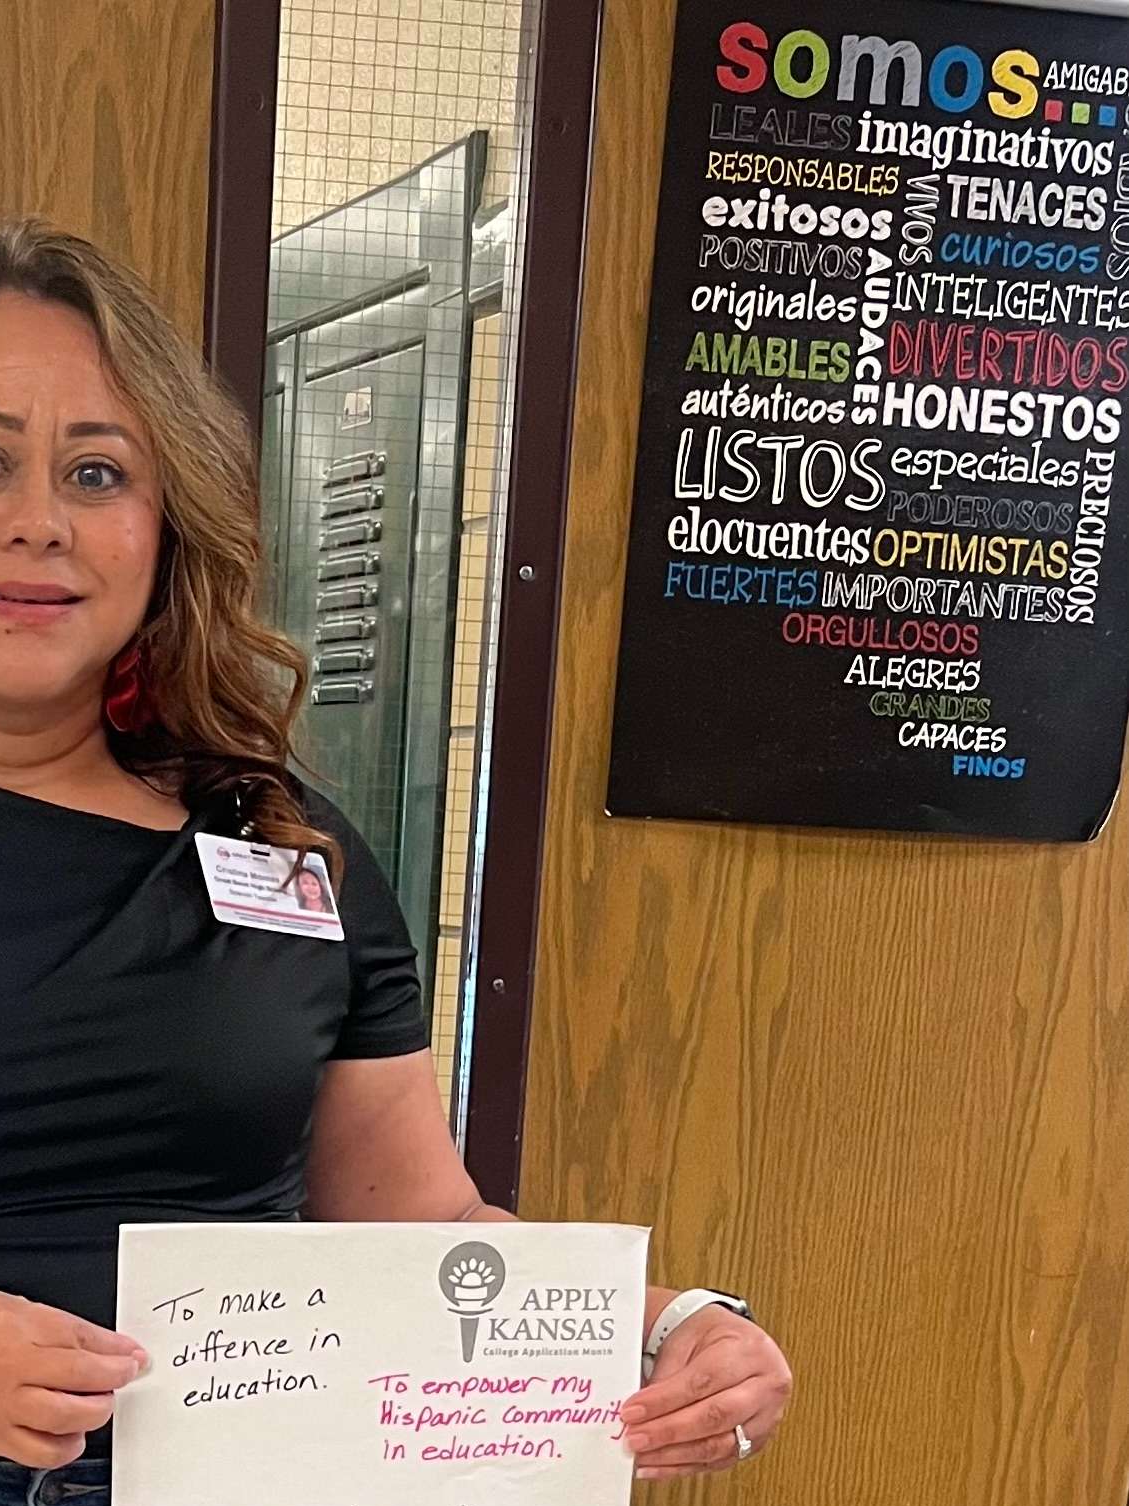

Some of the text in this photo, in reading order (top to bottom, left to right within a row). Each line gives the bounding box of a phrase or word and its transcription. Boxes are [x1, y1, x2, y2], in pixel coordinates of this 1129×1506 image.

[1043, 60, 1129, 97] AMIGAB
[710, 103, 853, 151] LEALES
[856, 111, 1115, 177] imaginativos
[705, 152, 899, 195] RESPONSABLES
[702, 188, 892, 242] exitosos
[898, 173, 941, 264] VIVOS
[947, 175, 1107, 231] TENACES
[699, 235, 863, 280] POSITIVOS
[941, 231, 1101, 273] curiosos
[691, 279, 857, 330] originales
[892, 272, 1129, 331] INTELIGENTES
[851, 247, 892, 424] AUDACES
[888, 320, 1129, 393] DIVERTIDOS
[685, 333, 851, 383] AMABLES
[681, 379, 846, 423] auténticos
[883, 382, 1121, 444] HONESTOS
[675, 426, 886, 511] LISTOS
[890, 442, 1081, 491] especiales
[886, 491, 1073, 533] PODEROSOS
[668, 506, 870, 567] elocuentes
[873, 529, 1068, 579] OPTIMISTAS
[1065, 448, 1116, 625] PRECIOSOS
[664, 562, 817, 606] FUERTES
[821, 571, 1064, 623] IMPORTANTES
[783, 613, 979, 654] ORGULLOSOS
[844, 655, 981, 691] ALEGRES
[869, 691, 991, 723] GRANDES
[898, 722, 1006, 752] CAPACES
[953, 755, 1027, 779] FINOS
[152, 1287, 326, 1324] To make a
[519, 1288, 618, 1311] APPLY
[172, 1327, 341, 1367] diffence in
[487, 1318, 615, 1341] KANSAS
[483, 1347, 613, 1358] College Application Month
[183, 1368, 327, 1407] education.
[368, 1374, 410, 1394] To
[421, 1376, 547, 1398] empower
[379, 1400, 487, 1432] Hispanic
[421, 1435, 562, 1461] education.
